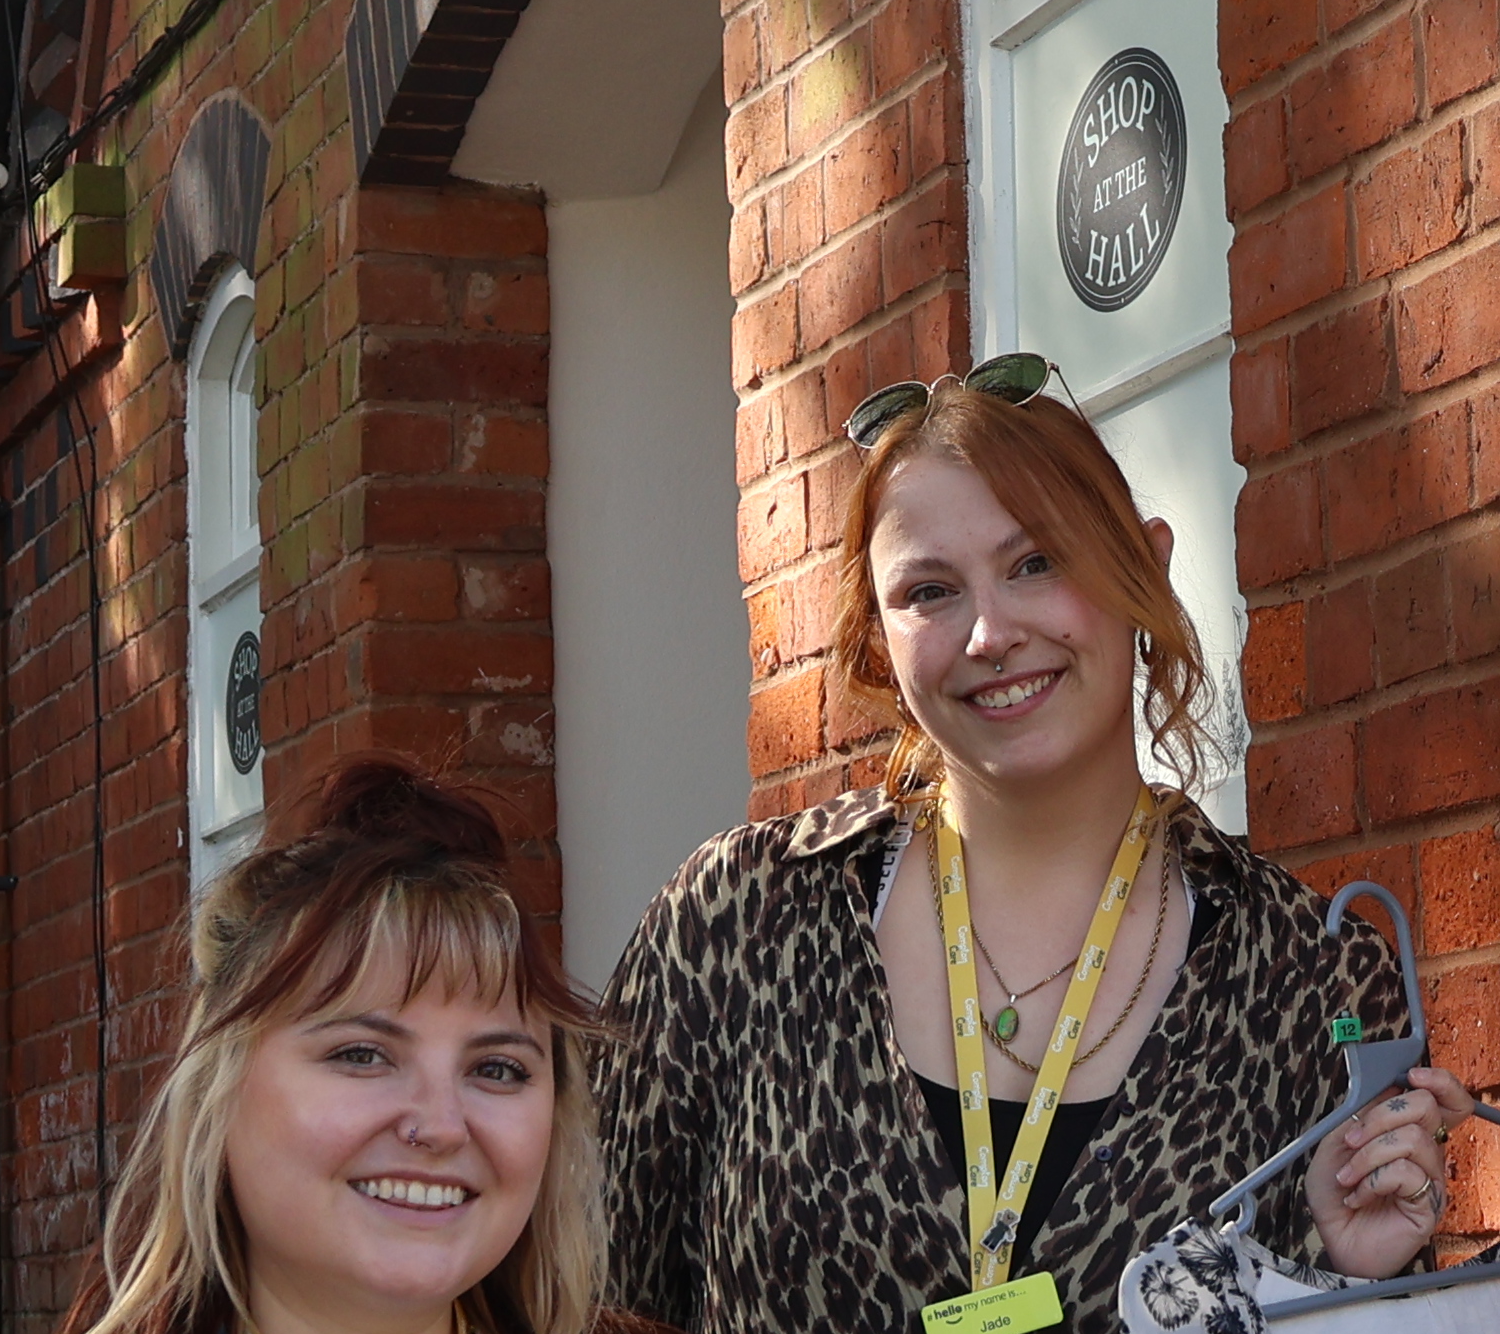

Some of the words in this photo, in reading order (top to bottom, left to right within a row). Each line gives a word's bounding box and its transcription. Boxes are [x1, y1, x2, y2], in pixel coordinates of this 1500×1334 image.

[1083, 75, 1155, 168] SHOP
[1093, 176, 1112, 213] AT
[1114, 156, 1147, 200] THE
[1084, 202, 1160, 287] HALL
[234, 646, 258, 692] SHOP
[235, 719, 259, 761] HALL
[1102, 875, 1125, 912] Compton
[1117, 881, 1130, 901] Care
[1077, 944, 1100, 982] Compton
[1092, 949, 1105, 969] Care
[955, 1017, 964, 1037] Care
[963, 998, 975, 1037] Compton
[1051, 1015, 1075, 1053] Compton
[1068, 1019, 1082, 1040] Care
[1340, 1024, 1356, 1037] 12
[1027, 1087, 1052, 1126] Compton
[1043, 1091, 1058, 1111] Care
[1002, 1160, 1029, 1201] Compton
[1019, 1163, 1034, 1184] Care
[964, 1301, 979, 1312] my
[980, 1292, 1007, 1306] name
[980, 1315, 1011, 1333] Jade
